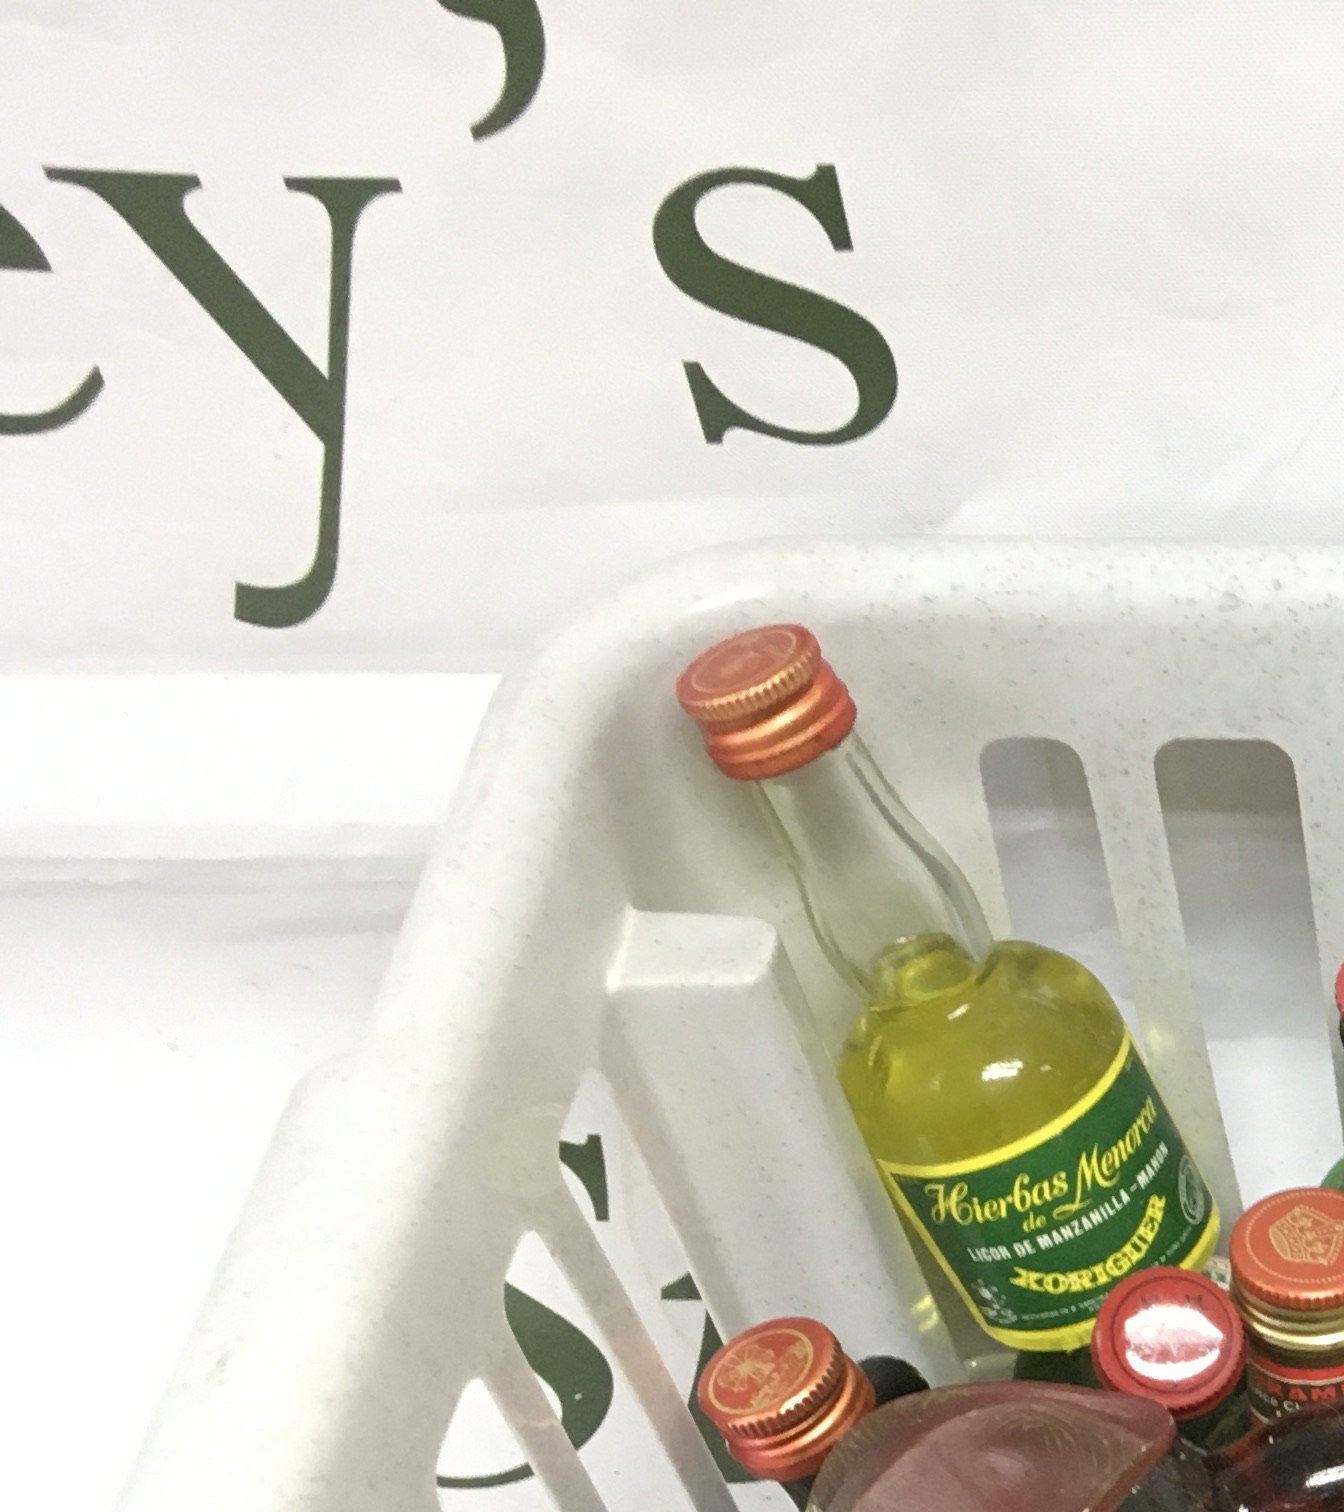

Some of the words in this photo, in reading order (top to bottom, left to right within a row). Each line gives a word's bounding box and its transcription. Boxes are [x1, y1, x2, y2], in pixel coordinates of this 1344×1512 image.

[924, 1170, 1069, 1226] Hierbas
[1022, 1211, 1047, 1233] de
[1051, 1096, 1159, 1220] Menorca
[966, 1243, 1012, 1263] LICOR
[1013, 1238, 1037, 1258] DE
[1038, 1188, 1132, 1251] MANZANILLA
